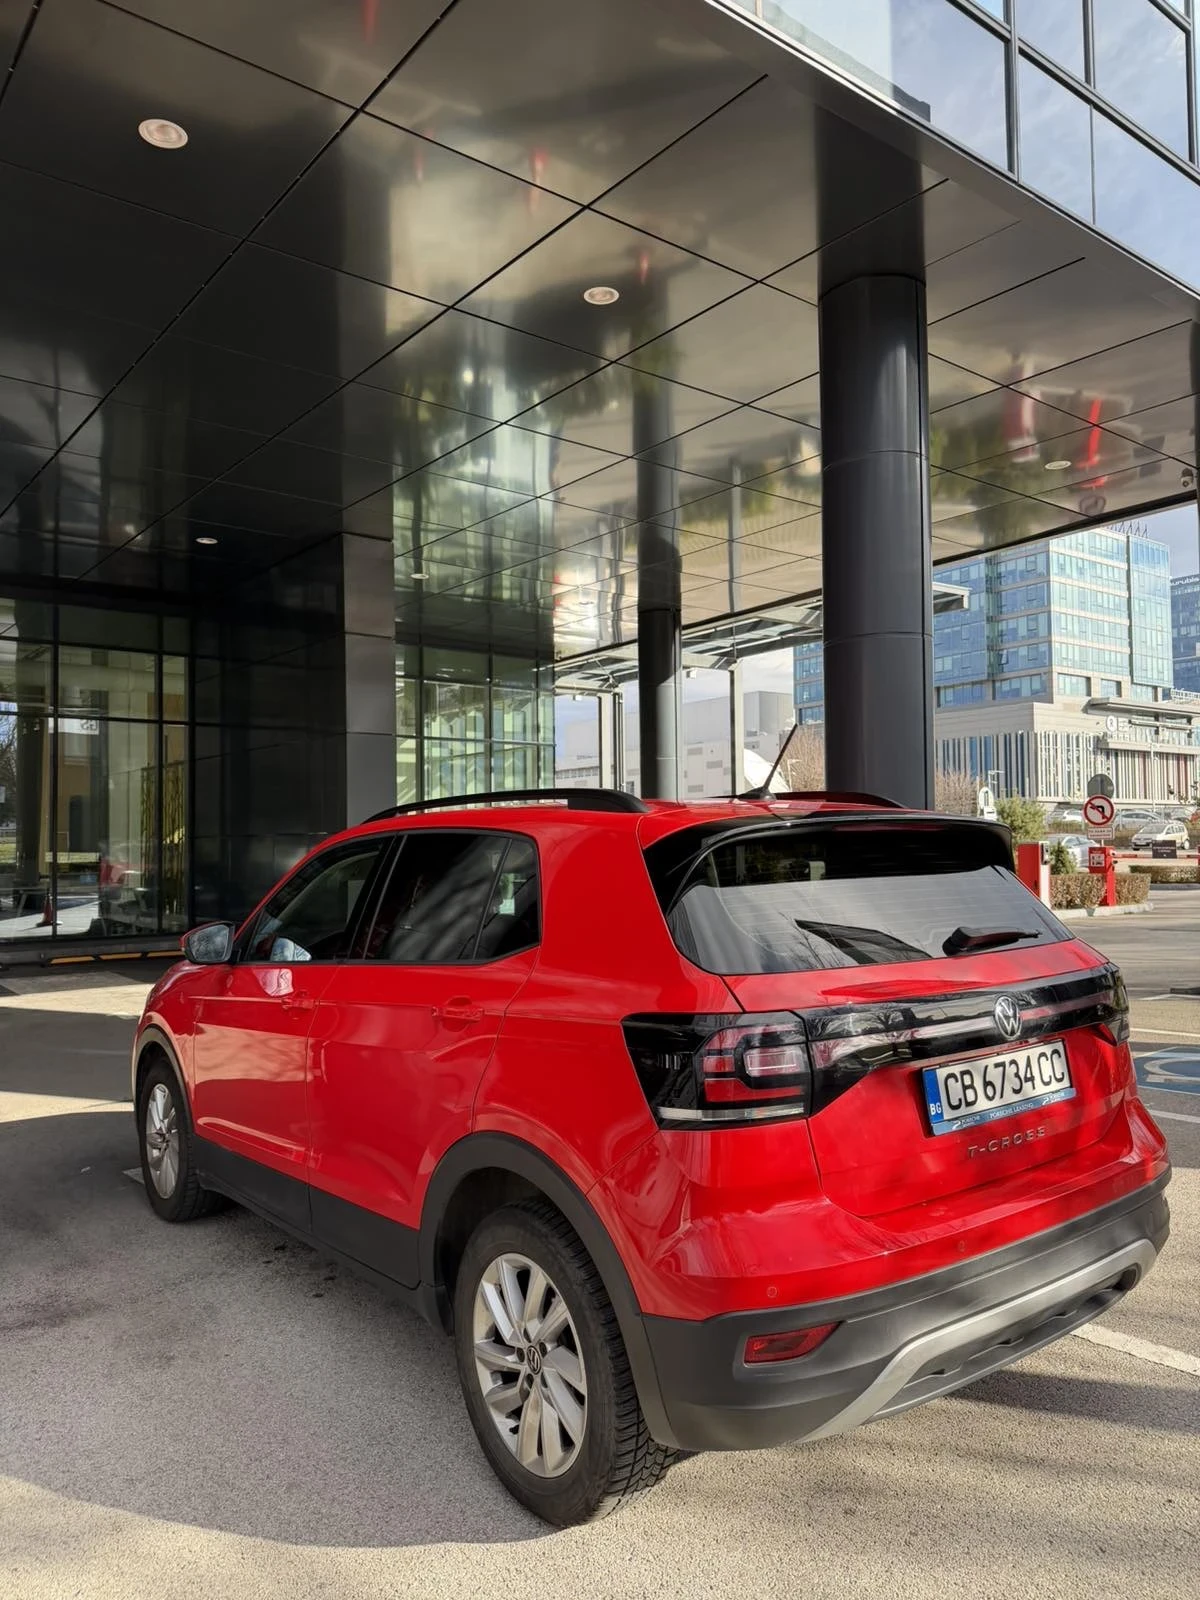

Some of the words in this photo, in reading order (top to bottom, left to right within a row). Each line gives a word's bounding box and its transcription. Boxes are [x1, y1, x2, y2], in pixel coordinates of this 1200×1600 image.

[944, 1071, 978, 1110] CB
[983, 1055, 1036, 1102] 6734
[1037, 1048, 1065, 1087] CC
[930, 1102, 942, 1115] BG
[968, 1126, 1046, 1158] T-CROSS
